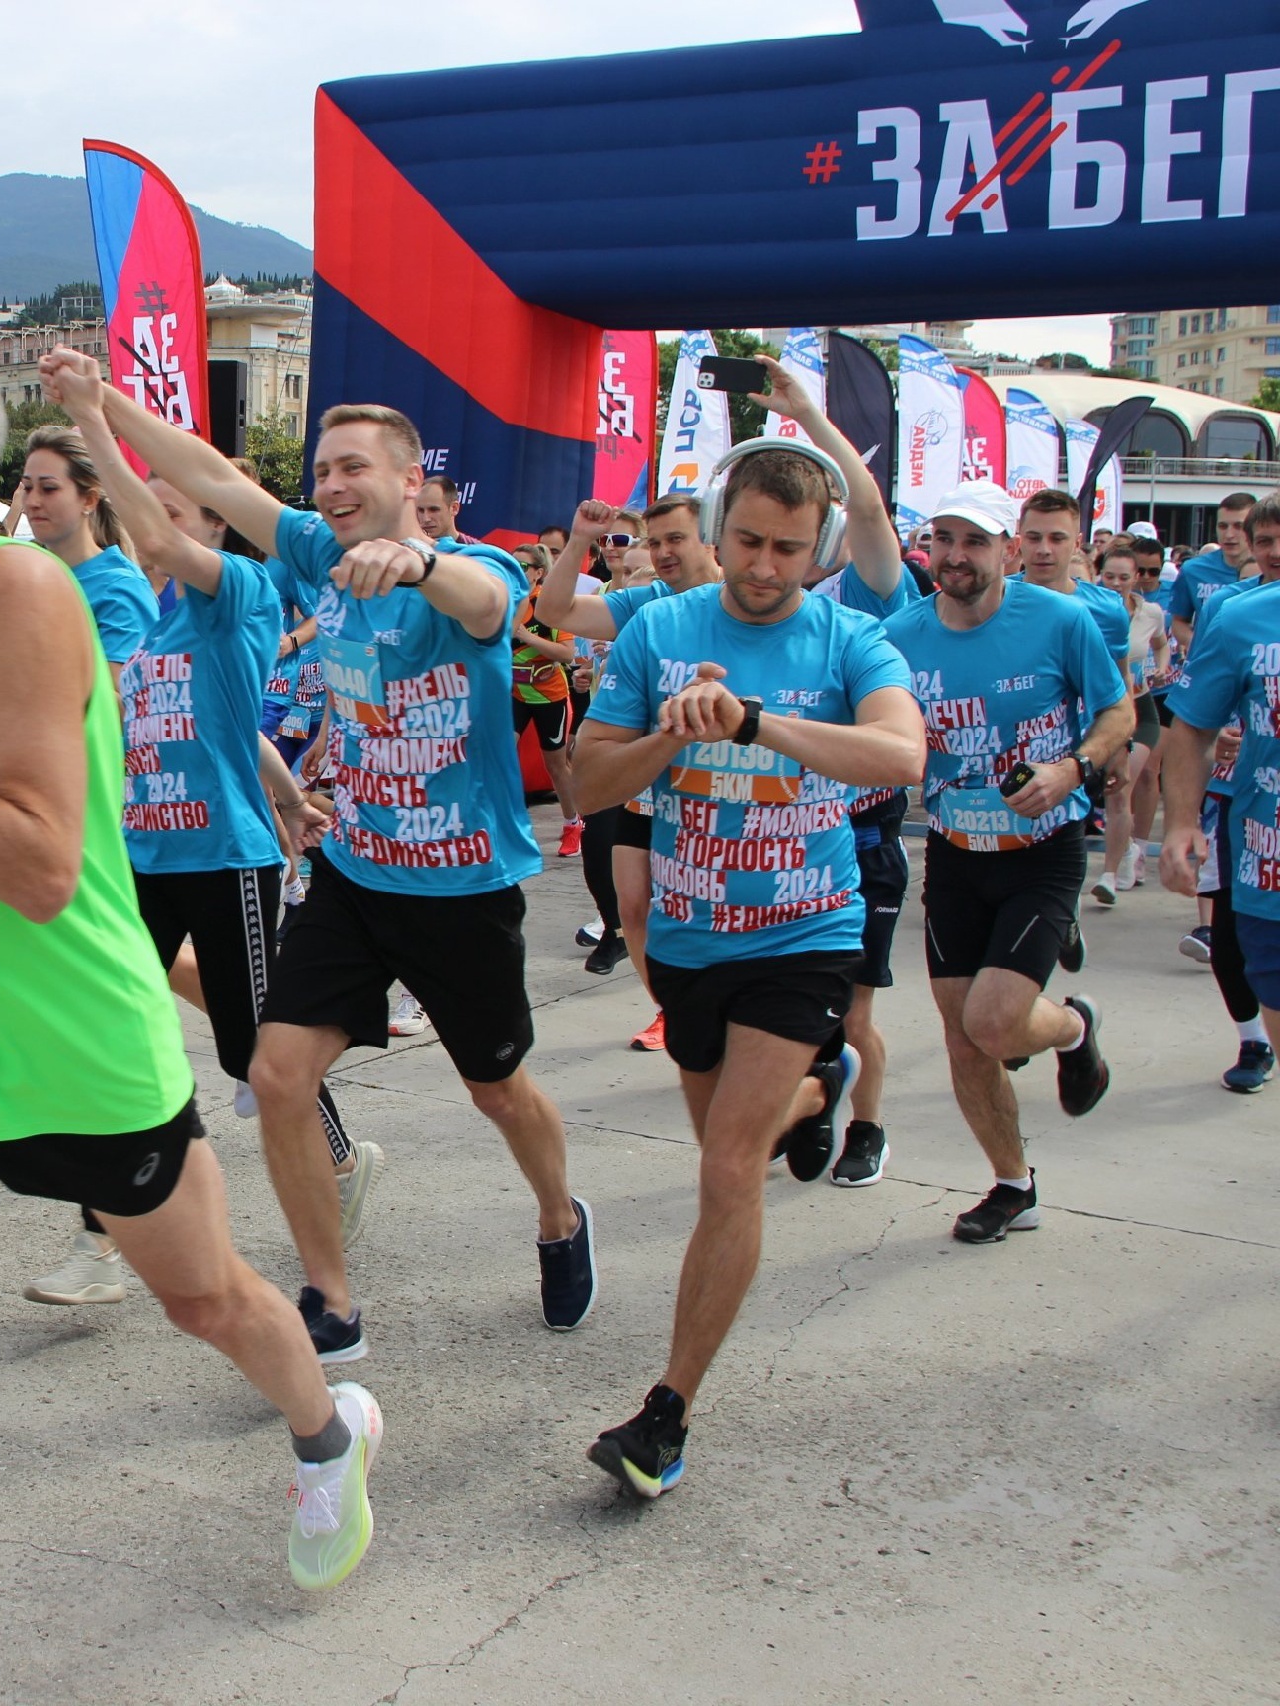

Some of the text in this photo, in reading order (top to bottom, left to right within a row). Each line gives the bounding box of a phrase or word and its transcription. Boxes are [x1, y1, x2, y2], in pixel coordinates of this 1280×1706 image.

[657, 658, 699, 694] 202
[407, 700, 472, 738] 2024
[948, 725, 1001, 756] 2024
[710, 772, 754, 801] 5KM
[395, 802, 464, 842] 2024
[953, 808, 1009, 832] 20213
[967, 834, 999, 851] 5KM
[774, 865, 833, 905] 2024
